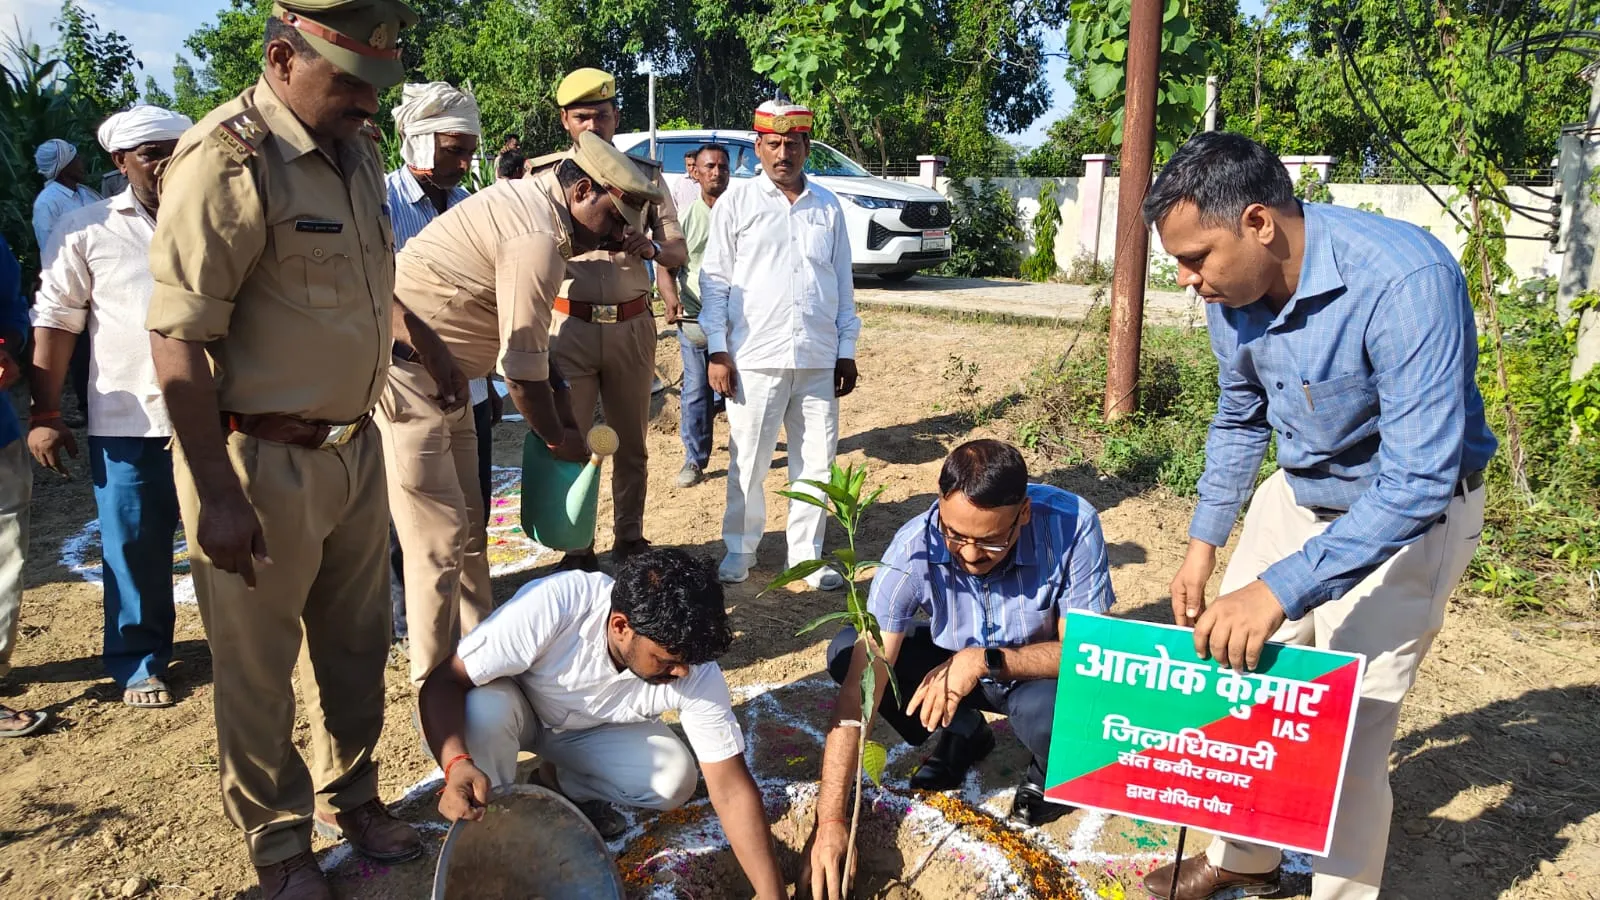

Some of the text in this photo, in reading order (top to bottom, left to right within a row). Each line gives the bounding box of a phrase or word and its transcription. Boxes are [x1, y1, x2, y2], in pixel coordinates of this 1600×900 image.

[1075, 642, 1330, 720] आलोक कुमार
[1102, 714, 1278, 771] जिलाधिकारी
[1271, 718, 1310, 742] IAS
[1117, 748, 1253, 789] संत कबीर नगर
[1126, 783, 1233, 815] द्वारा रोपित पौध
